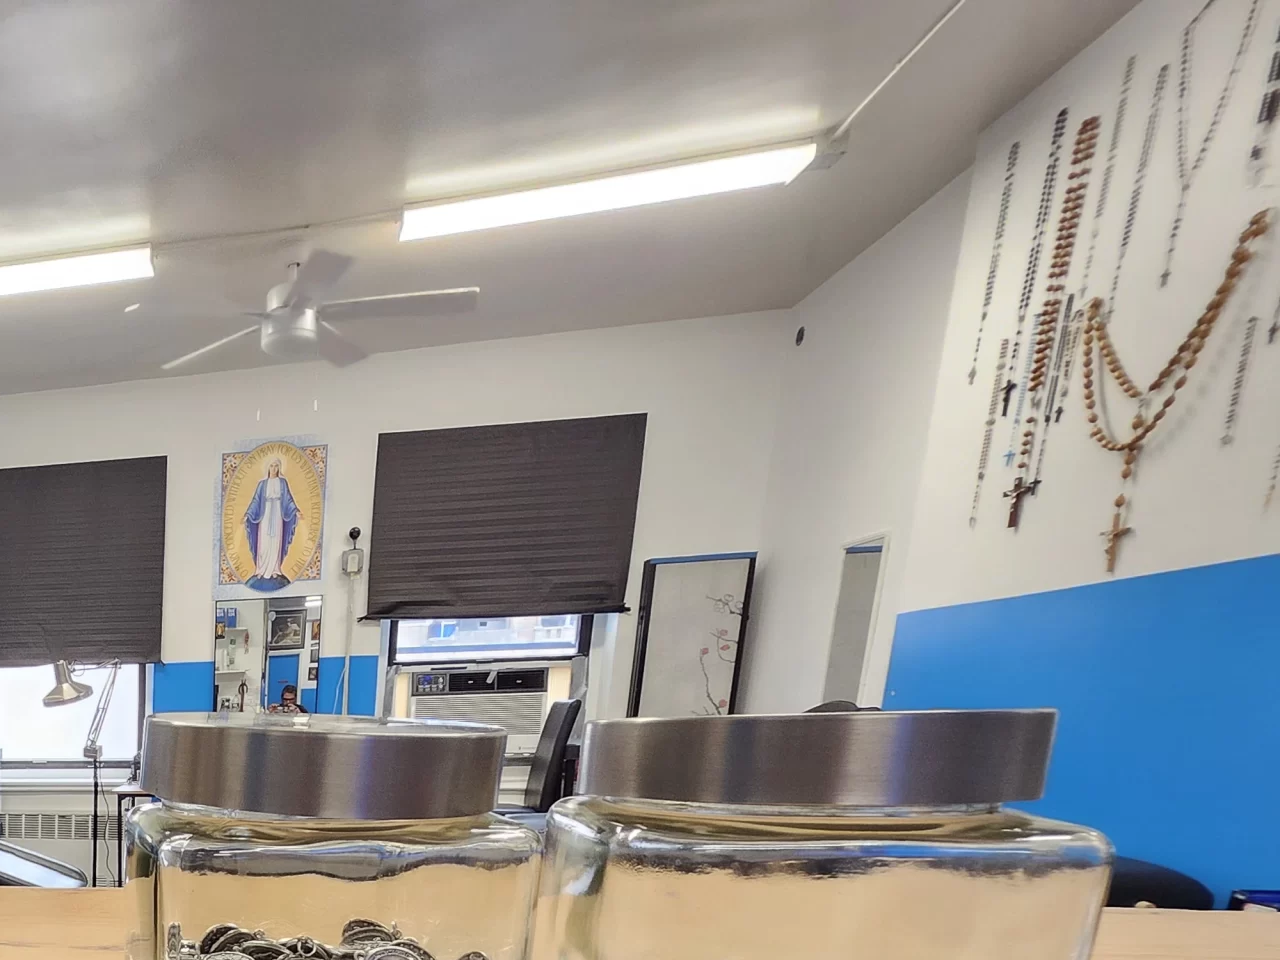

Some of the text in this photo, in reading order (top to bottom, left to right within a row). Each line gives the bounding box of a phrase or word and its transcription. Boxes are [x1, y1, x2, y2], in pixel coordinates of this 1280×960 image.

[257, 444, 276, 460] PRAY
[277, 444, 291, 457] FOR
[226, 467, 248, 503] WITHOUT
[224, 504, 234, 550] CONCEIVED
